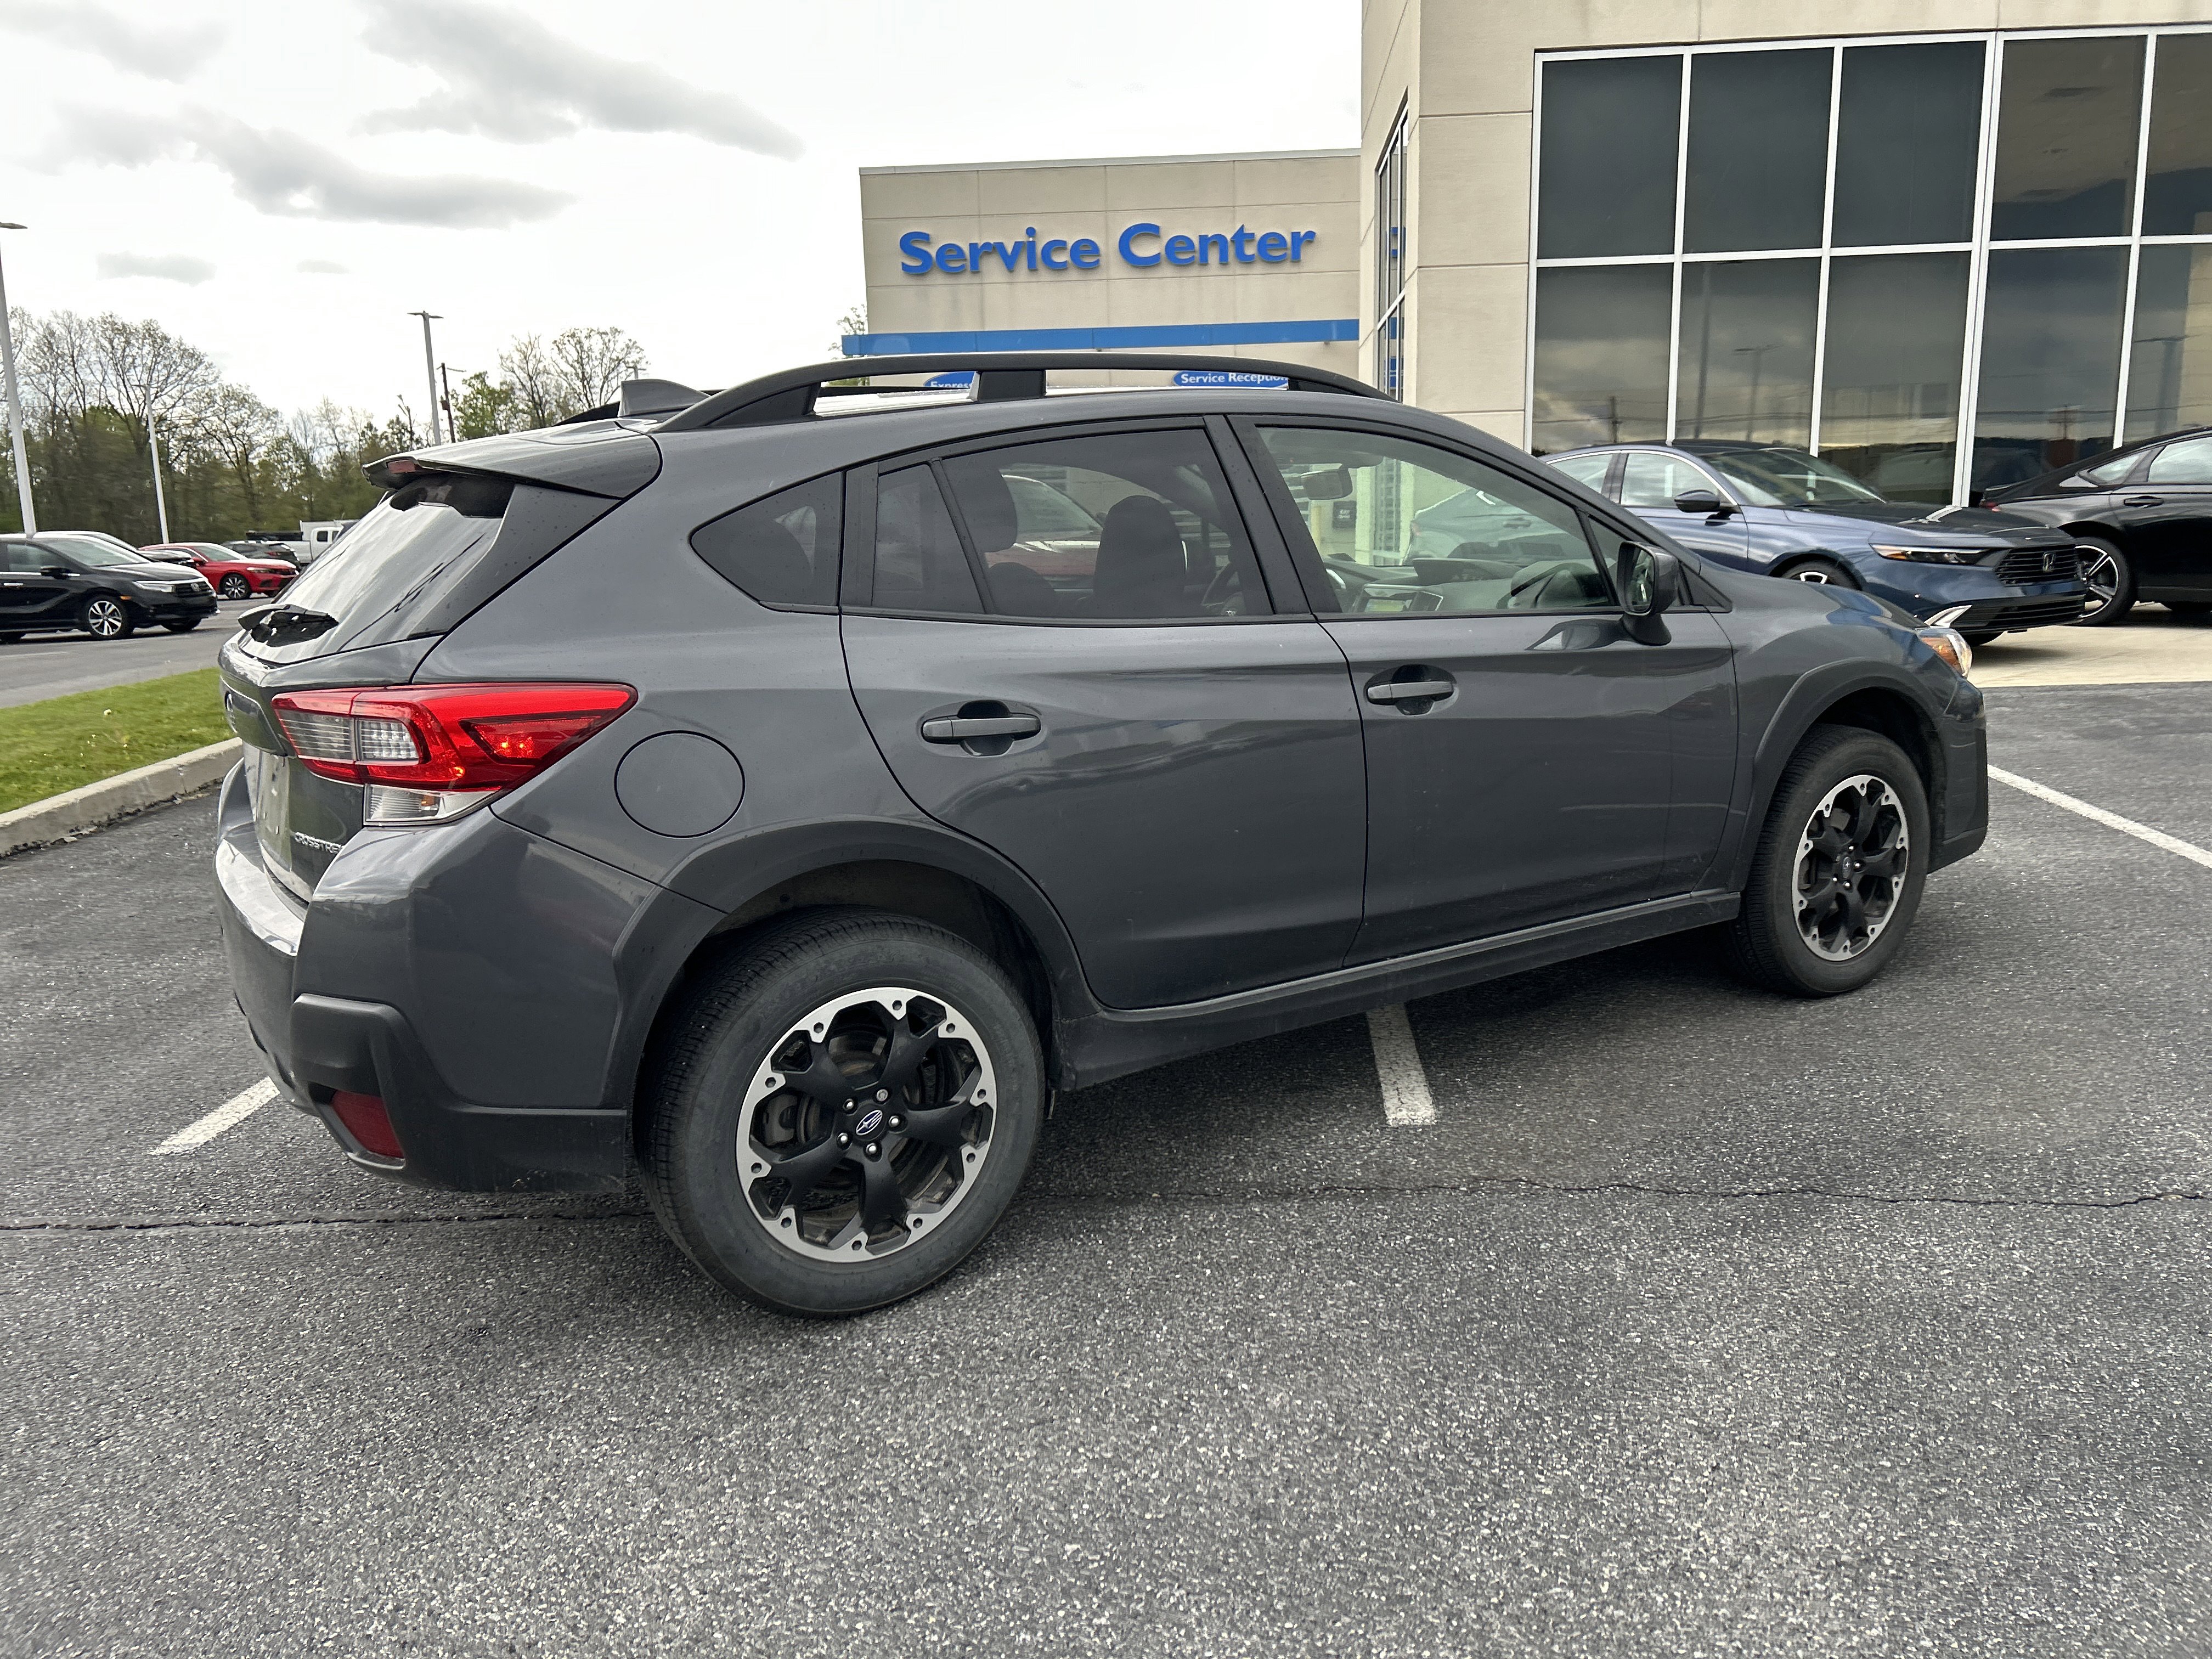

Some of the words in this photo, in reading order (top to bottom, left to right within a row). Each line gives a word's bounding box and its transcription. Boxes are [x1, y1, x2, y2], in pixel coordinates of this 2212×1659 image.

[899, 227, 1101, 274] Service
[1118, 223, 1316, 268] Center
[1181, 373, 1225, 383] Service
